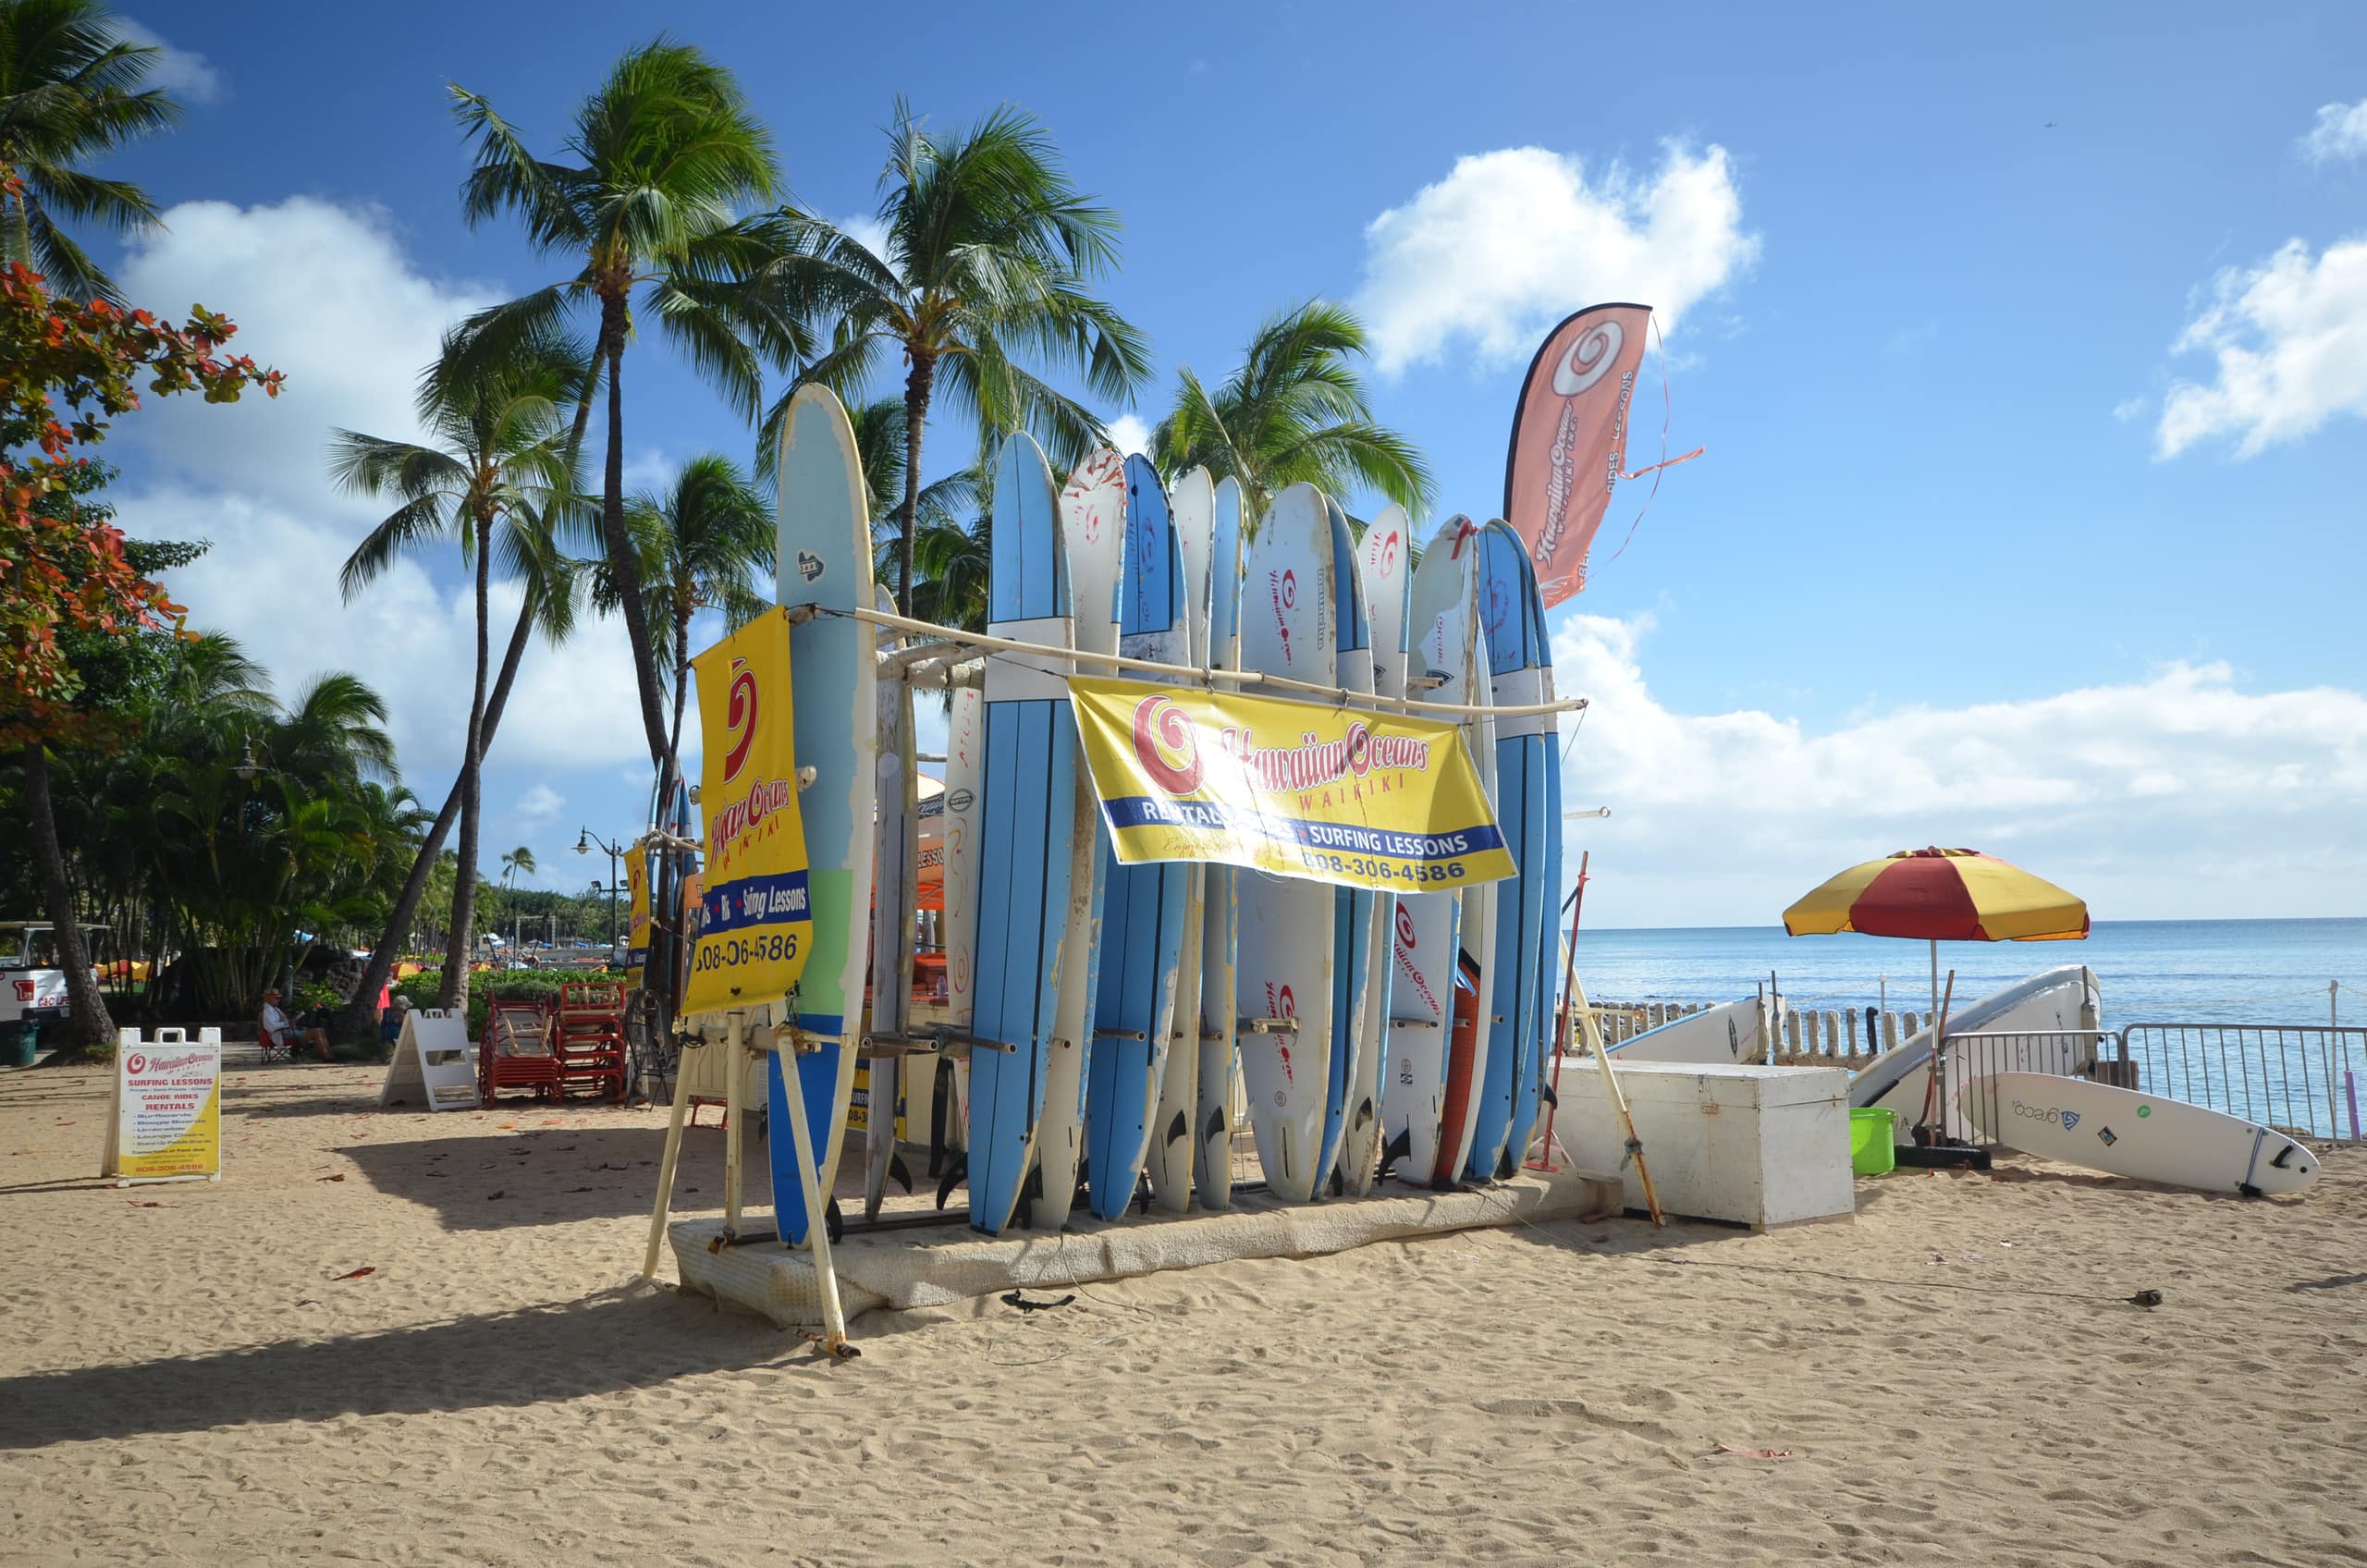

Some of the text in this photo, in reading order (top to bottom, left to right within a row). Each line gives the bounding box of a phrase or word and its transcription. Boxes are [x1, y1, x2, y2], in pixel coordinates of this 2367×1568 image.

[1536, 398, 1574, 570] Hawaiian Oceans
[1220, 721, 1429, 792] Hawaiian Oceans
[1298, 772, 1404, 811] WAIKIKI
[1142, 802, 1230, 826] RENTAL
[1309, 825, 1382, 851] SURFING
[1386, 834, 1468, 856] LESSONS
[1303, 851, 1466, 882] 808-306-4586
[768, 885, 806, 913] Lessons
[128, 1077, 214, 1086] SURFING LESSONS
[145, 1102, 195, 1110] RENTALS
